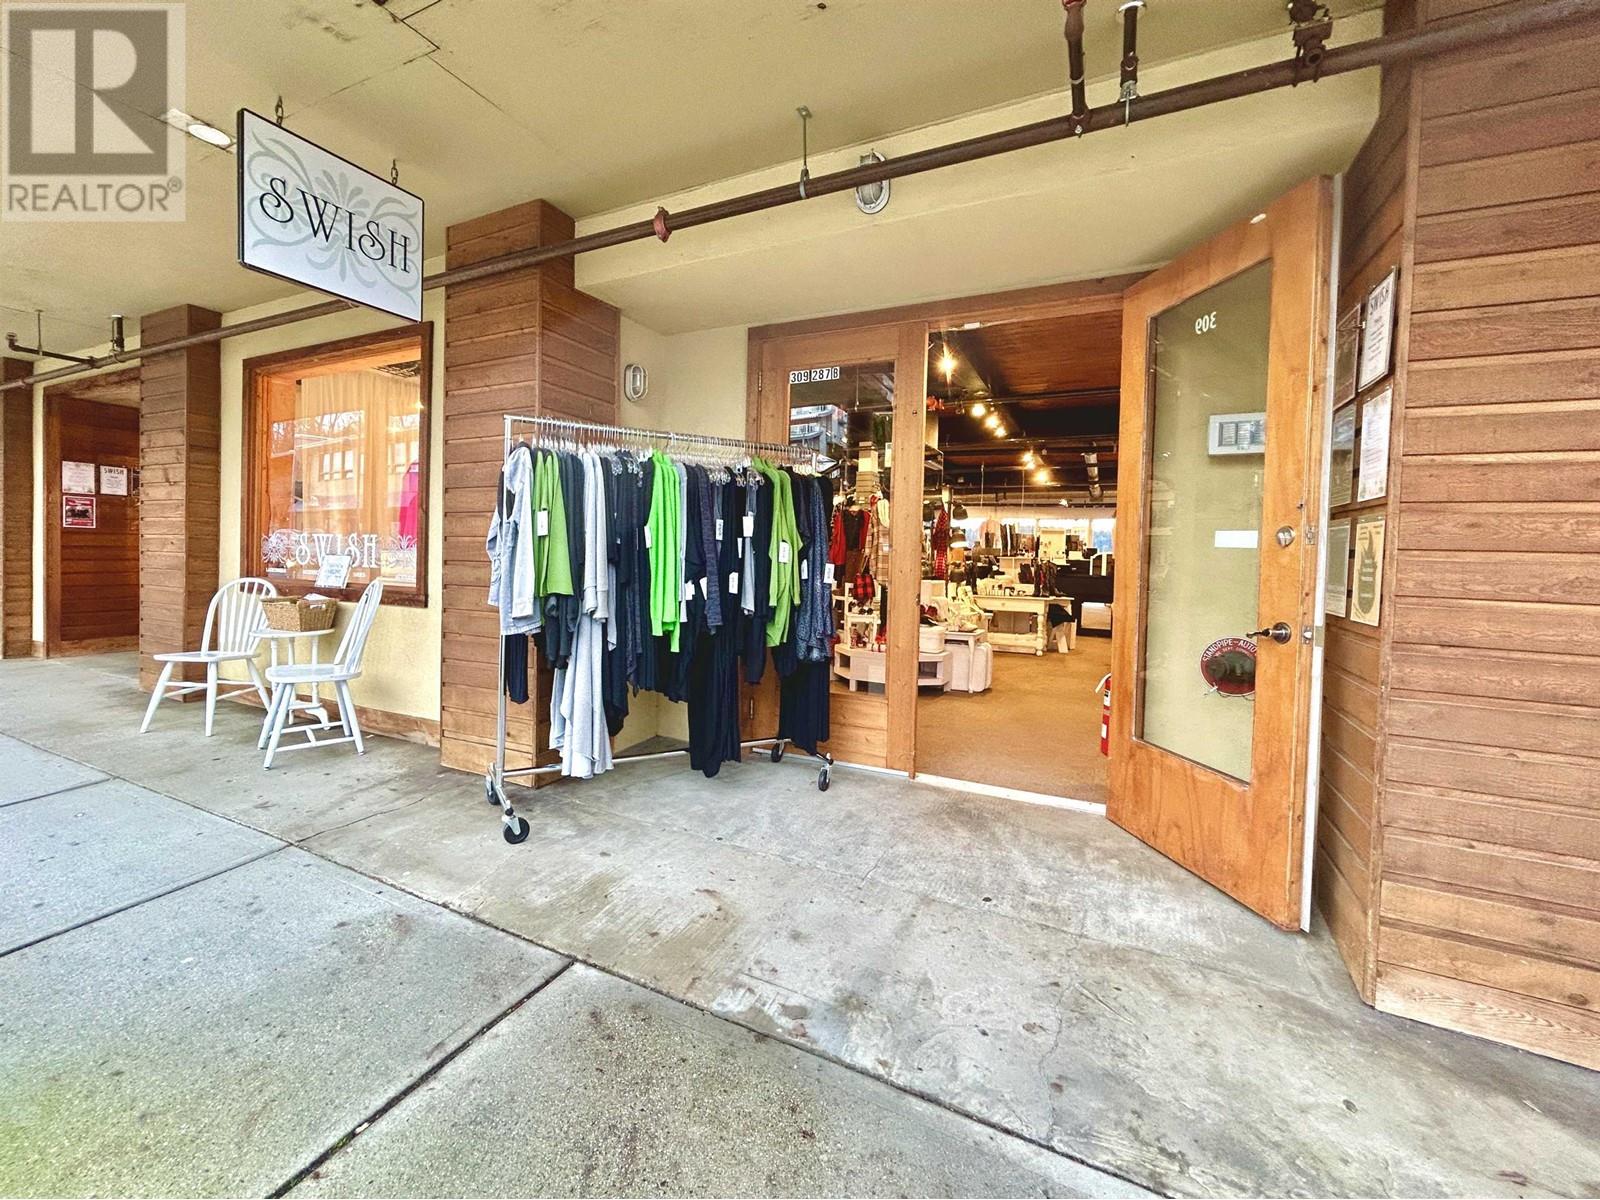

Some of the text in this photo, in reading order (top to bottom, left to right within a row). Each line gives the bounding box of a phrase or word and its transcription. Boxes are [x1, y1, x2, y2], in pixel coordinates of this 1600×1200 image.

[259, 177, 410, 273] SWISH
[791, 371, 809, 383] 309
[103, 467, 125, 475] SWISH
[295, 532, 379, 568] SWISH
[1202, 639, 1233, 661] STANDPIPE
